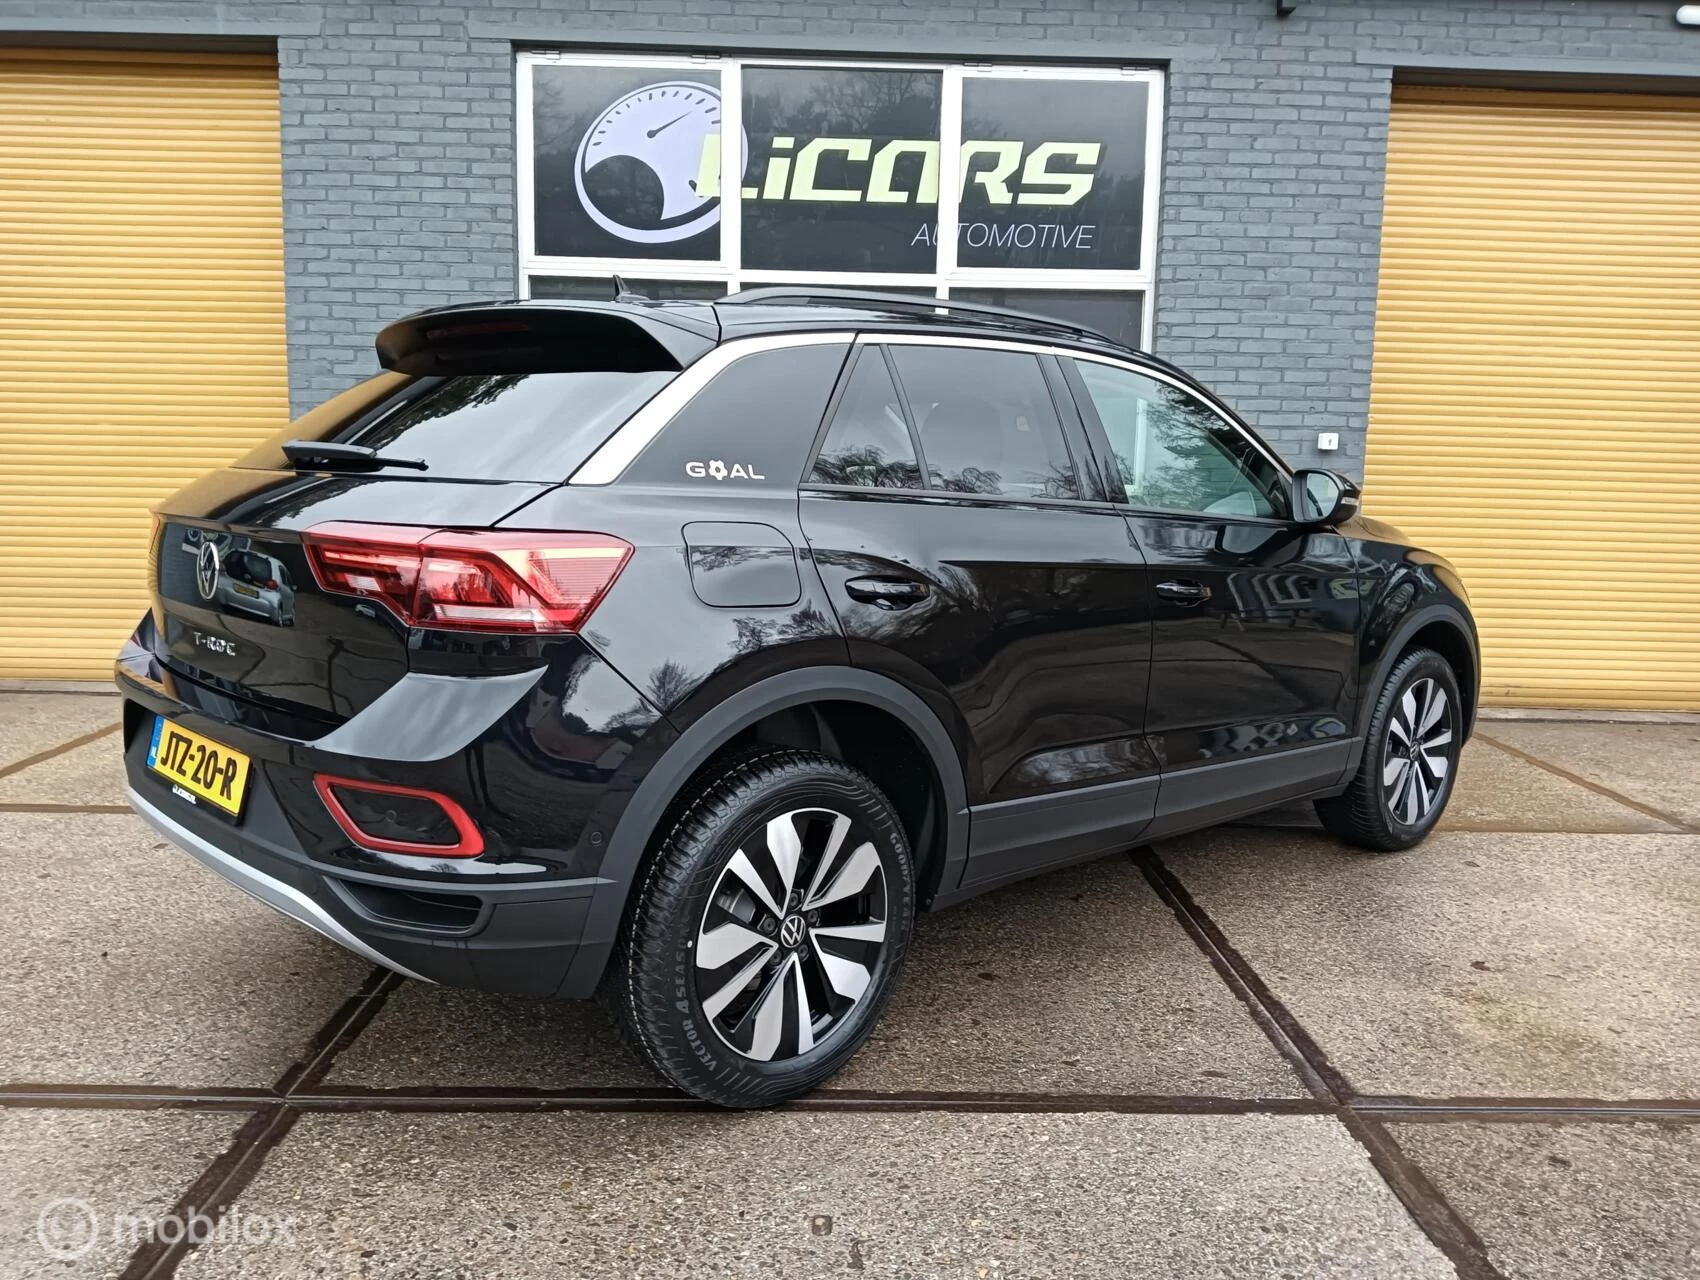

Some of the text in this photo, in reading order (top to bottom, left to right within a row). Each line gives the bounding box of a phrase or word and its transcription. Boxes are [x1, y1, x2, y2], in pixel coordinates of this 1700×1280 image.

[685, 459, 765, 481] GOAL
[160, 730, 237, 801] JTZ-20-R
[682, 1019, 717, 1071] VECTOR
